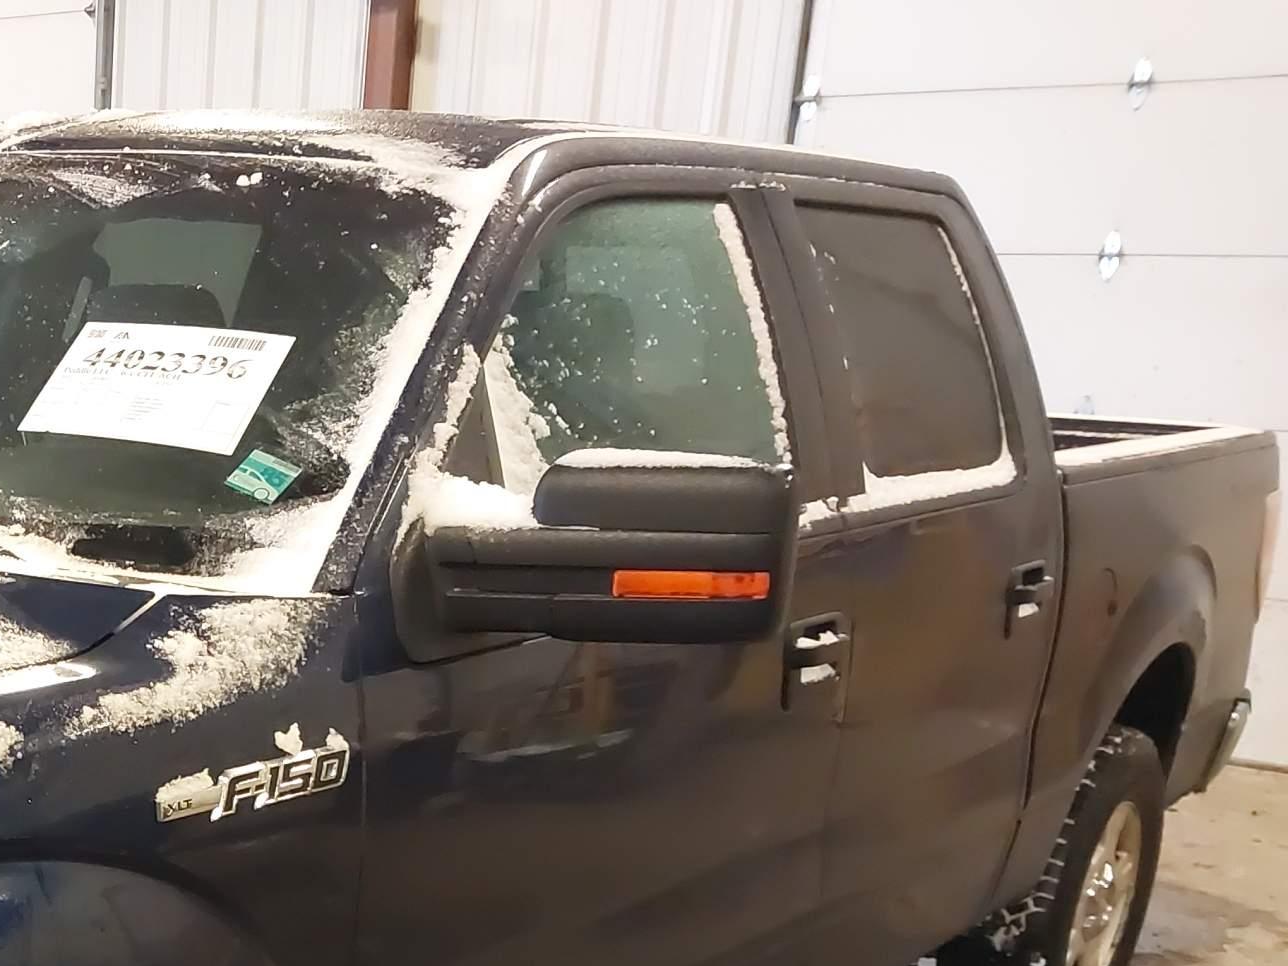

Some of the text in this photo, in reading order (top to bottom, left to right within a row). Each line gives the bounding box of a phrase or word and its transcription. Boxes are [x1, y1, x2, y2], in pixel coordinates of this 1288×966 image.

[82, 346, 257, 381] 44023396
[165, 747, 351, 817] XLT F-150
